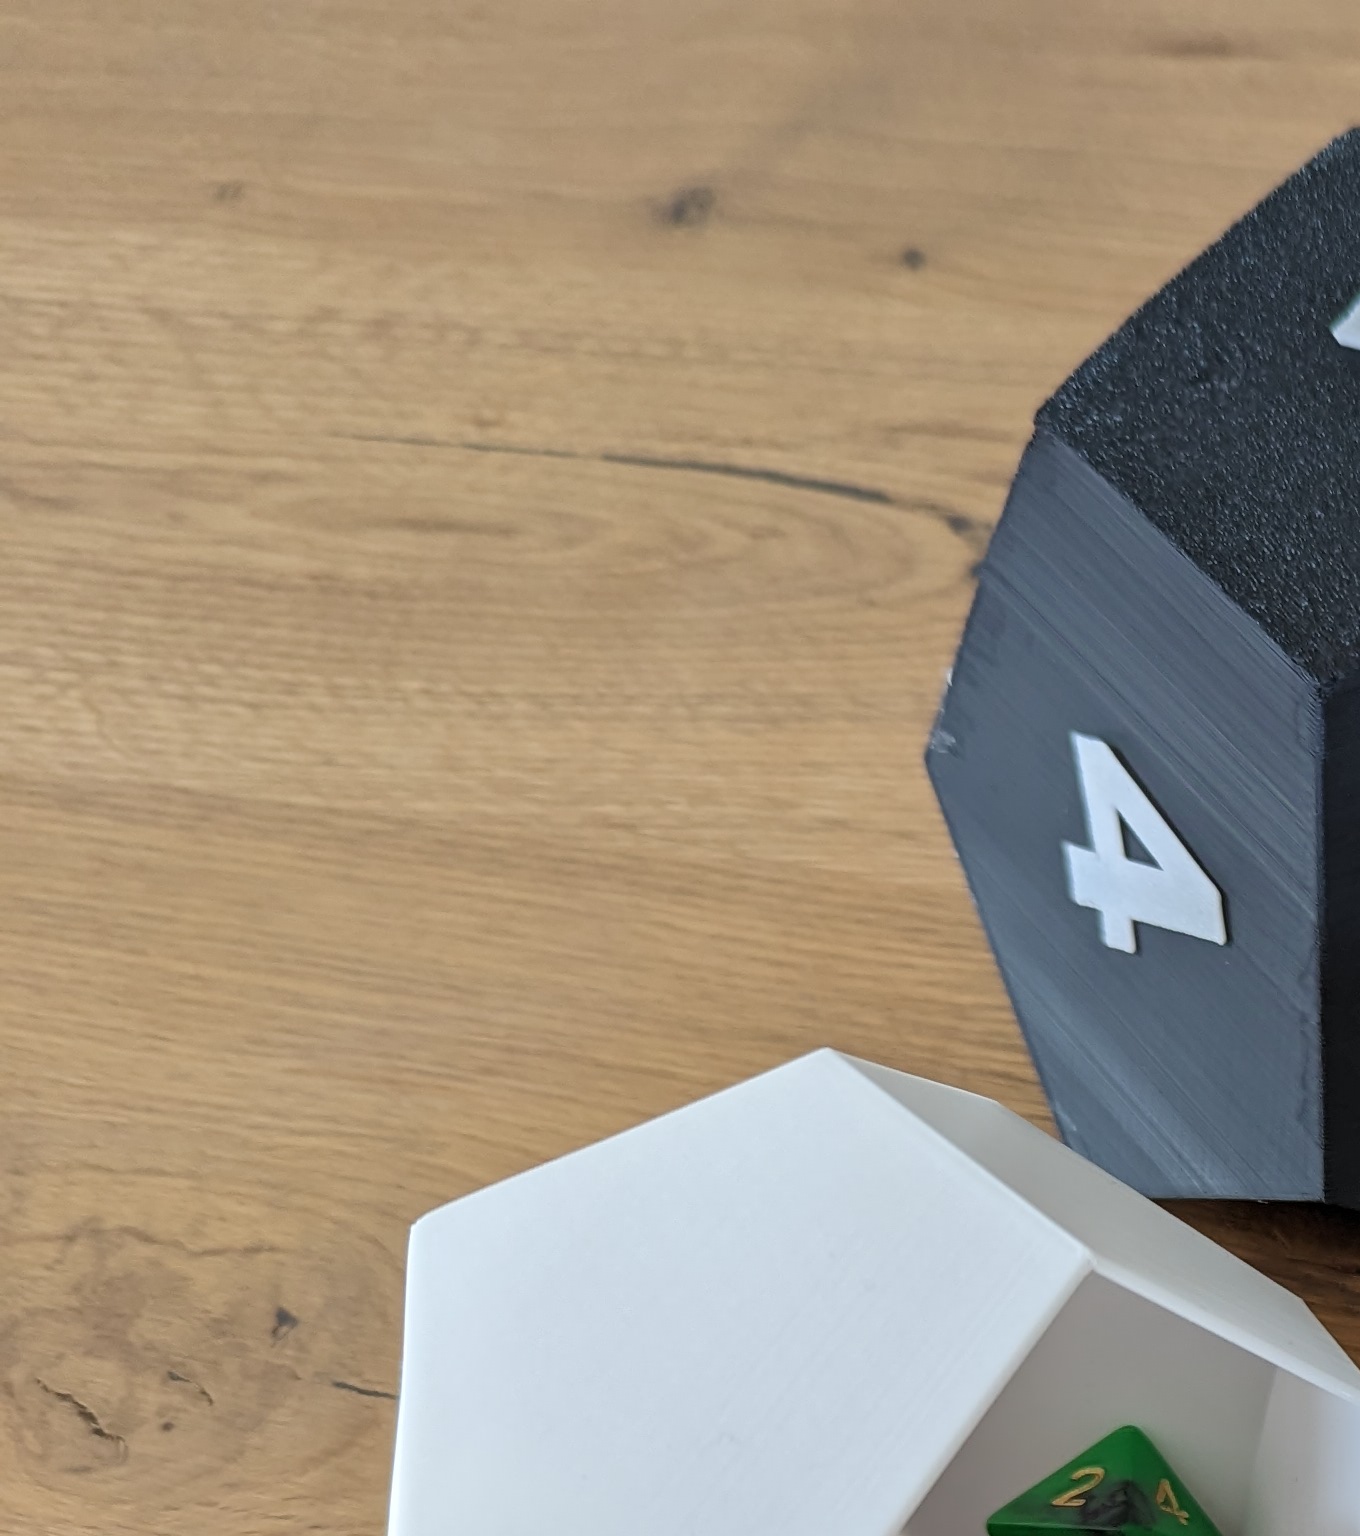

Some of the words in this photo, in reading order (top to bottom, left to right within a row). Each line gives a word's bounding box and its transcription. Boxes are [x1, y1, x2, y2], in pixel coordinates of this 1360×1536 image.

[1062, 730, 1228, 954] 4
[1052, 1467, 1105, 1506] 2
[1156, 1479, 1189, 1525] 4
